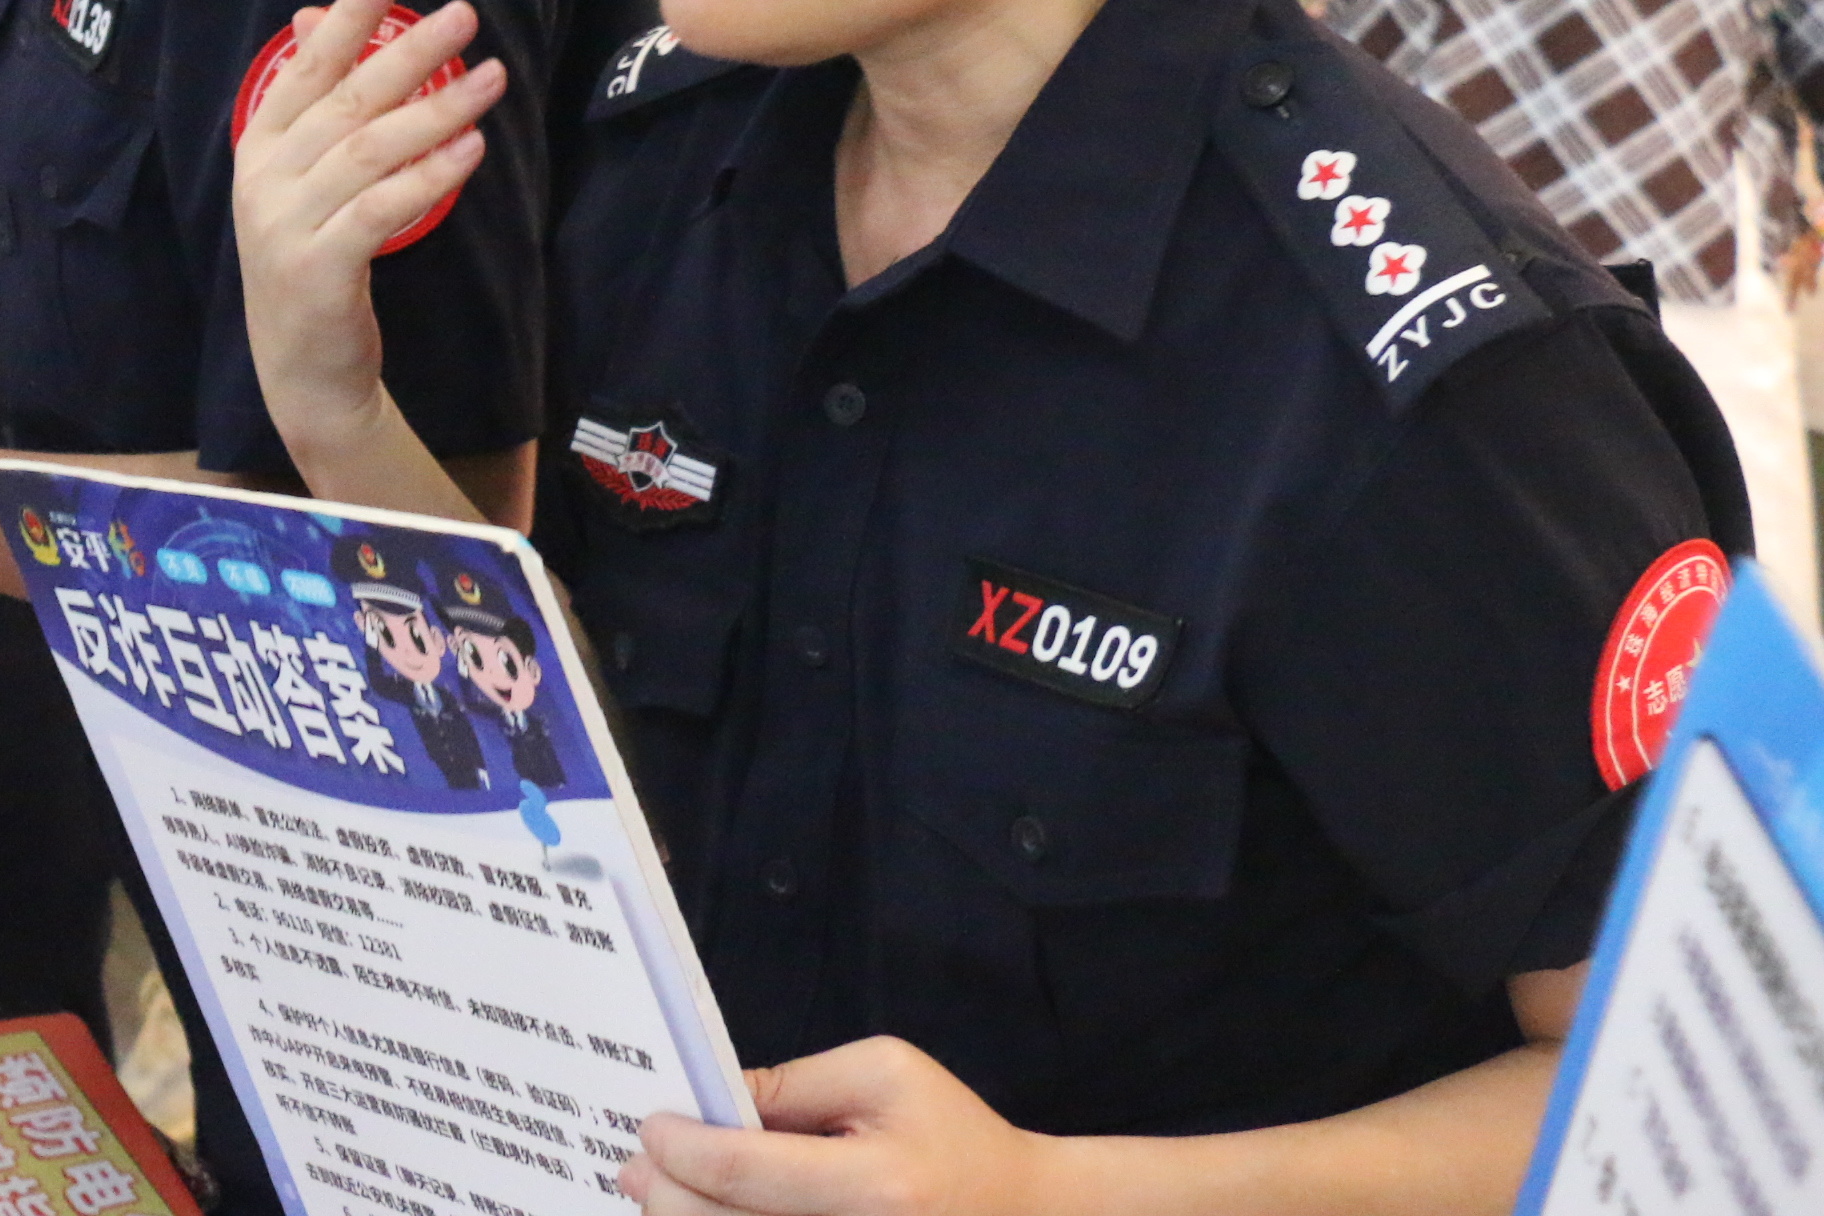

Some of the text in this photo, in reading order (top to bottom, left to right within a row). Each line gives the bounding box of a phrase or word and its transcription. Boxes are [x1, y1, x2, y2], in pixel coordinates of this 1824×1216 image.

[1376, 282, 1506, 383] ZYJC
[54, 587, 407, 775] 反诈互动答案
[967, 579, 1158, 689] XZ0109
